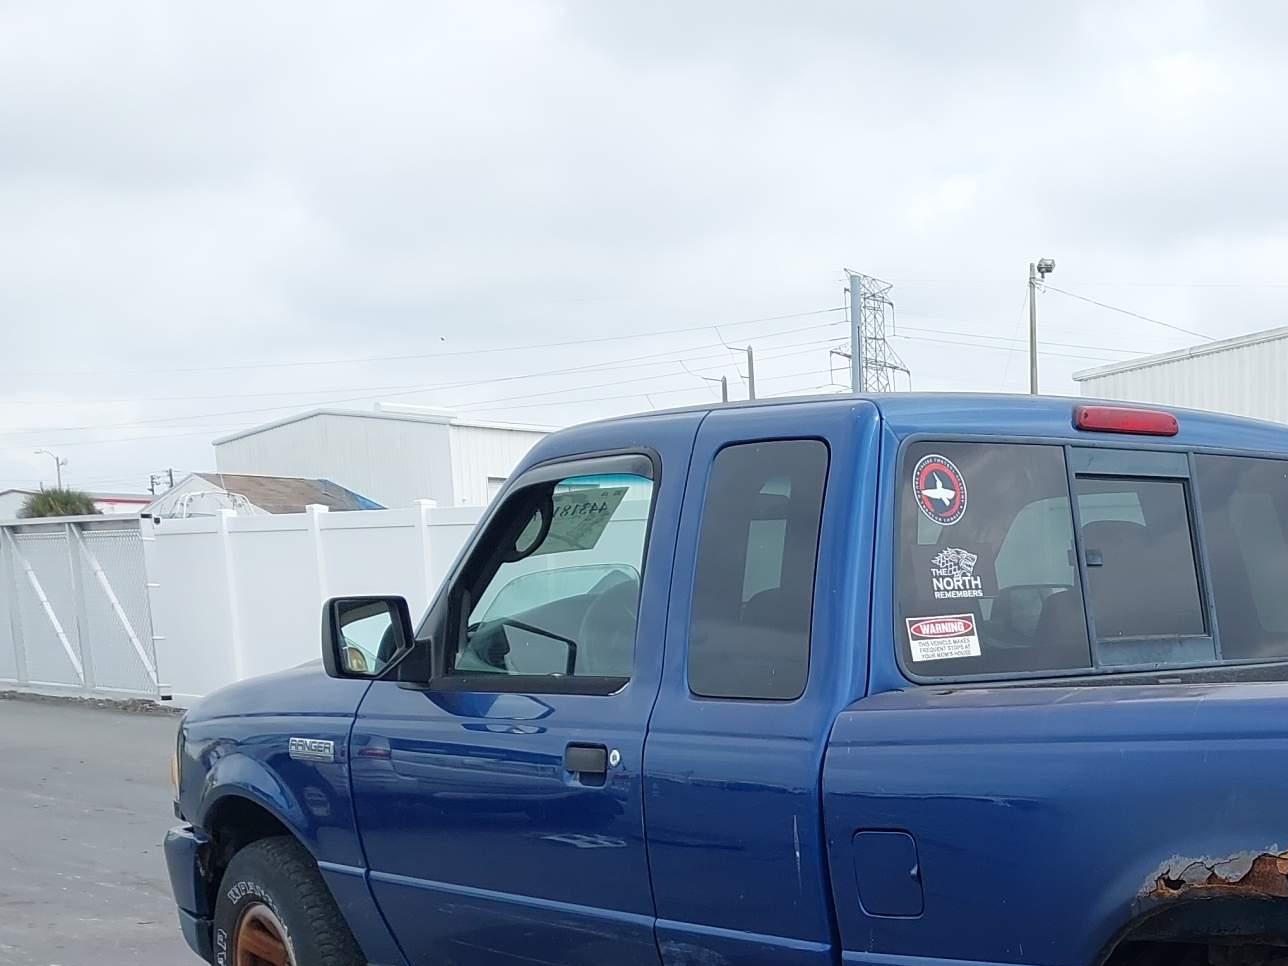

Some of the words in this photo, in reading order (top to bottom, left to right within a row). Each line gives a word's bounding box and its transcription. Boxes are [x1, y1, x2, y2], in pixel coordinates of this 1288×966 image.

[931, 568, 948, 576] THE
[932, 576, 982, 590] NORTH
[934, 589, 984, 599] REMEMBERS
[920, 622, 964, 634] WARNING
[290, 739, 331, 752] RANGER
